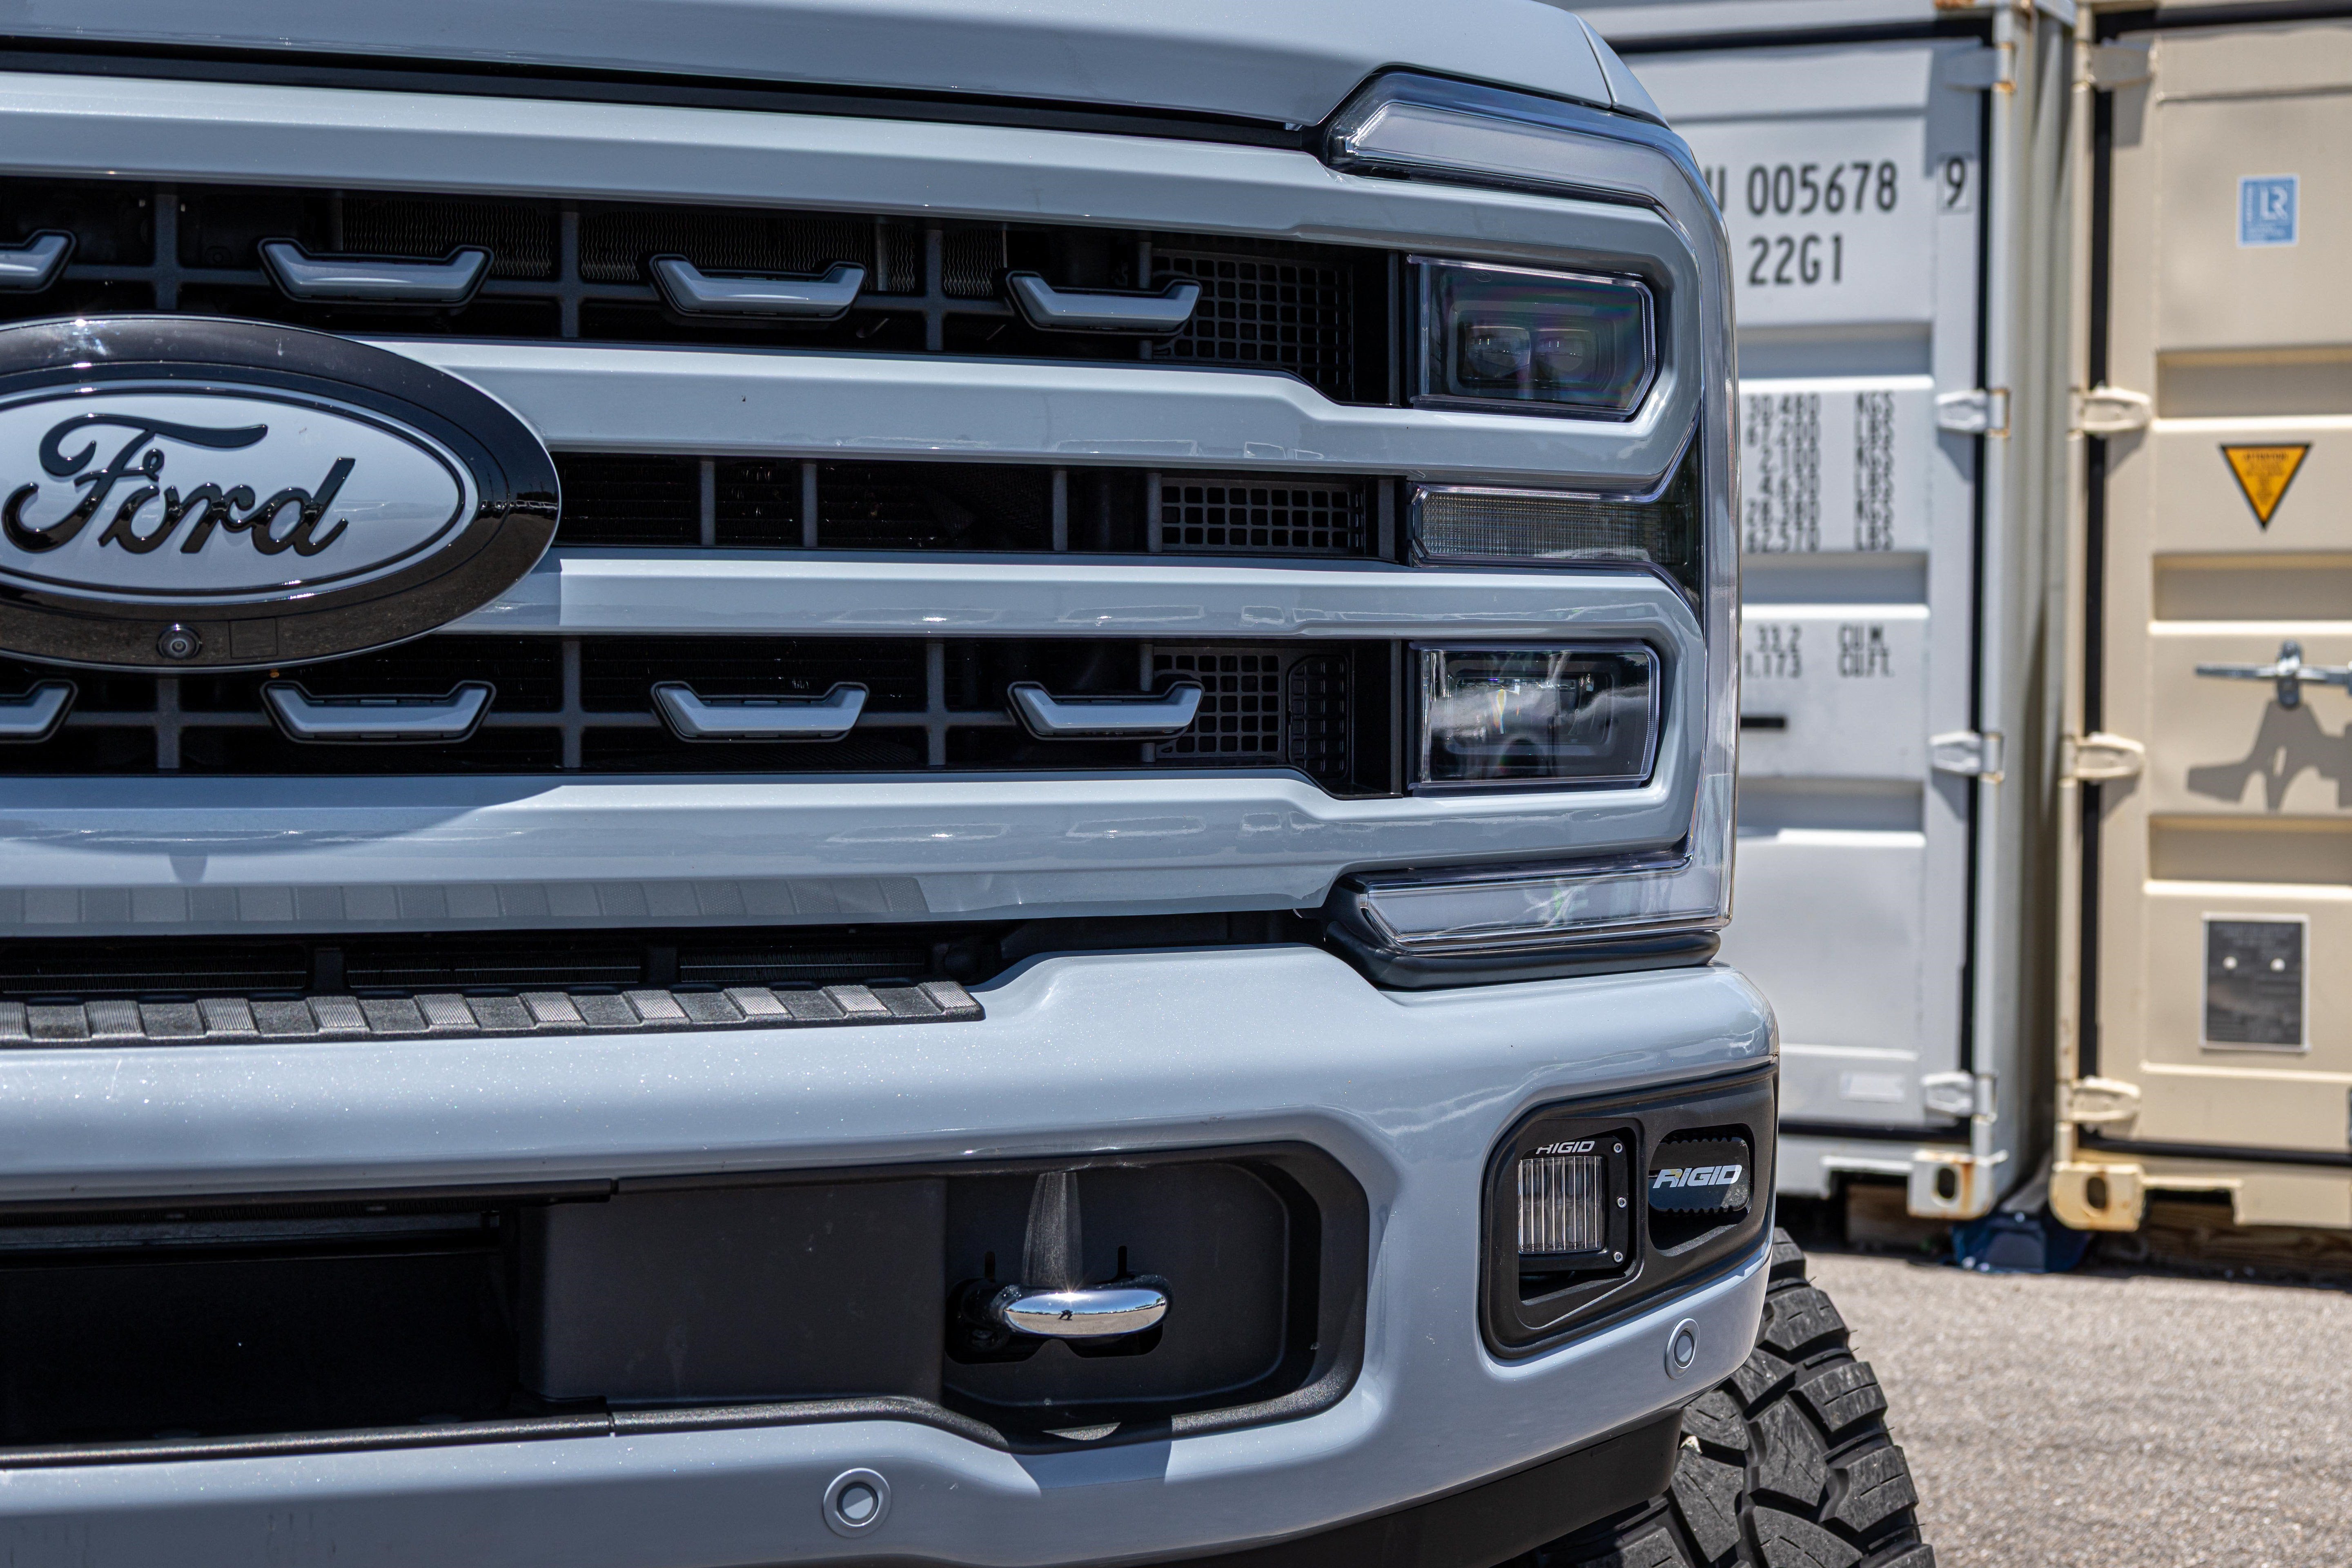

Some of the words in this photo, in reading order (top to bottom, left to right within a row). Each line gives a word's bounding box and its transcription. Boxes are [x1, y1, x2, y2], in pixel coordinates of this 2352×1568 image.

[1747, 159, 1898, 216] 005678
[1944, 157, 1967, 208] 9
[1748, 233, 1843, 286] 22G1
[2, 412, 356, 557] Ford
[1535, 1140, 1595, 1154] RIGID
[1653, 1164, 1742, 1189] RIGID
